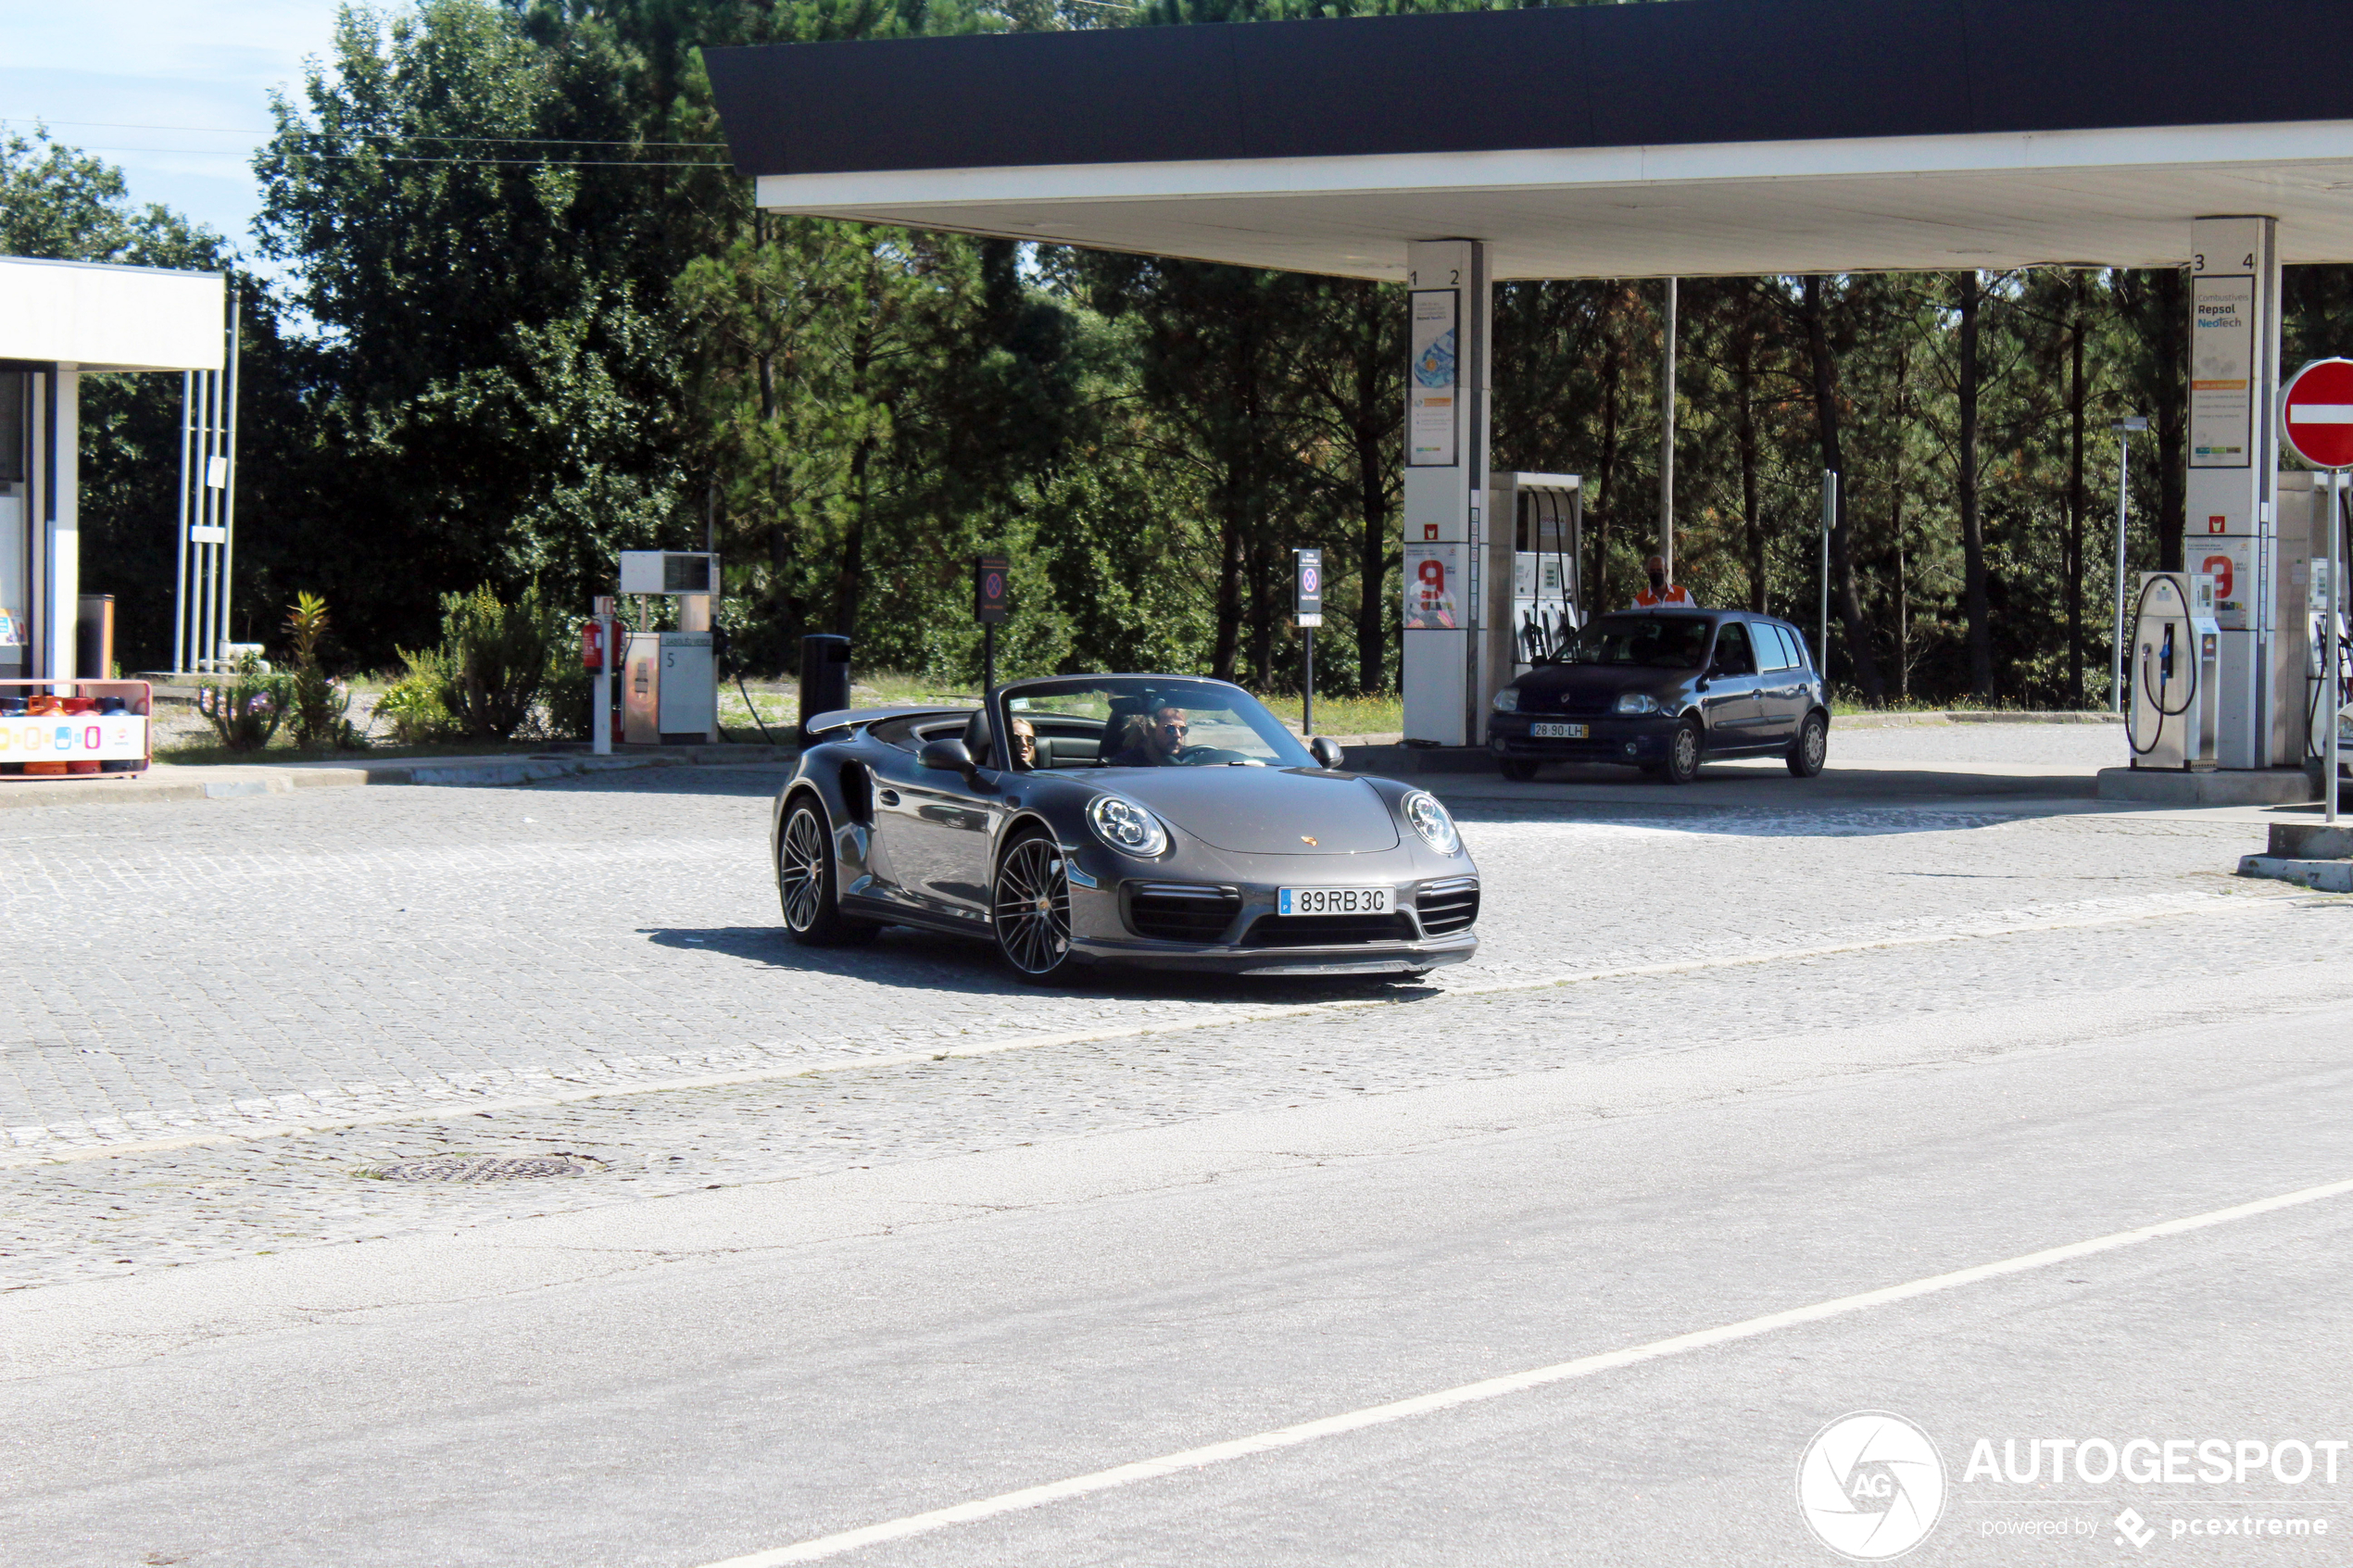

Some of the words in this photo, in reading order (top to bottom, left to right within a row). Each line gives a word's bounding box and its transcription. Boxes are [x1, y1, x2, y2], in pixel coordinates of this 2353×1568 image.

[2194, 254, 2205, 270] 3
[2242, 253, 2254, 270] 4
[1410, 270, 1417, 285] 1
[1450, 270, 1459, 284] 2
[2197, 304, 2235, 316] Repsol
[666, 652, 675, 668] 5
